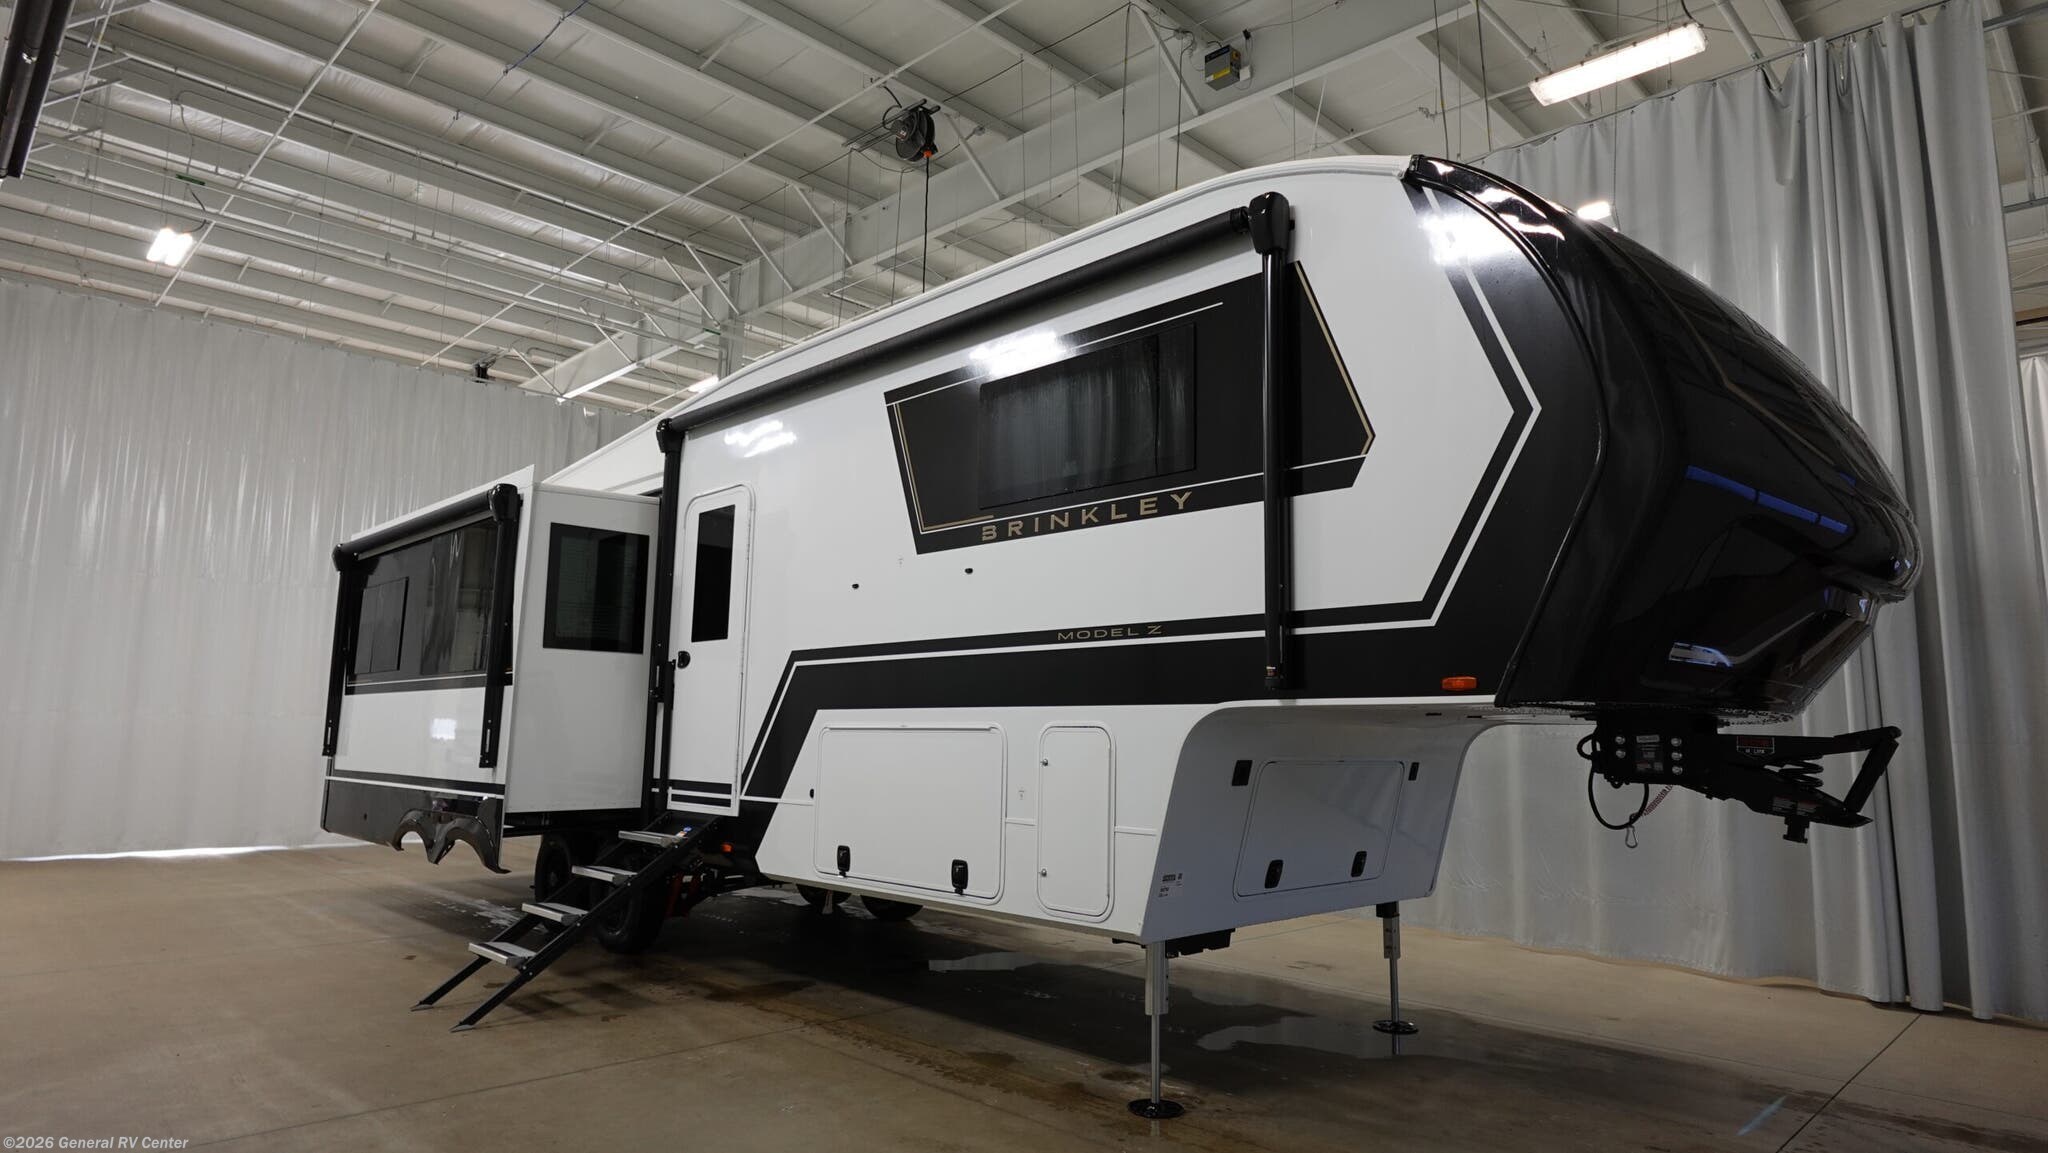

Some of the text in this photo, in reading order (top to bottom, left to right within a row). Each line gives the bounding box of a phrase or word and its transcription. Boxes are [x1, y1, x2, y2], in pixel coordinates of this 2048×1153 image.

[981, 491, 1192, 541] BRINKLEY
[1057, 625, 1162, 641] MODEL Z
